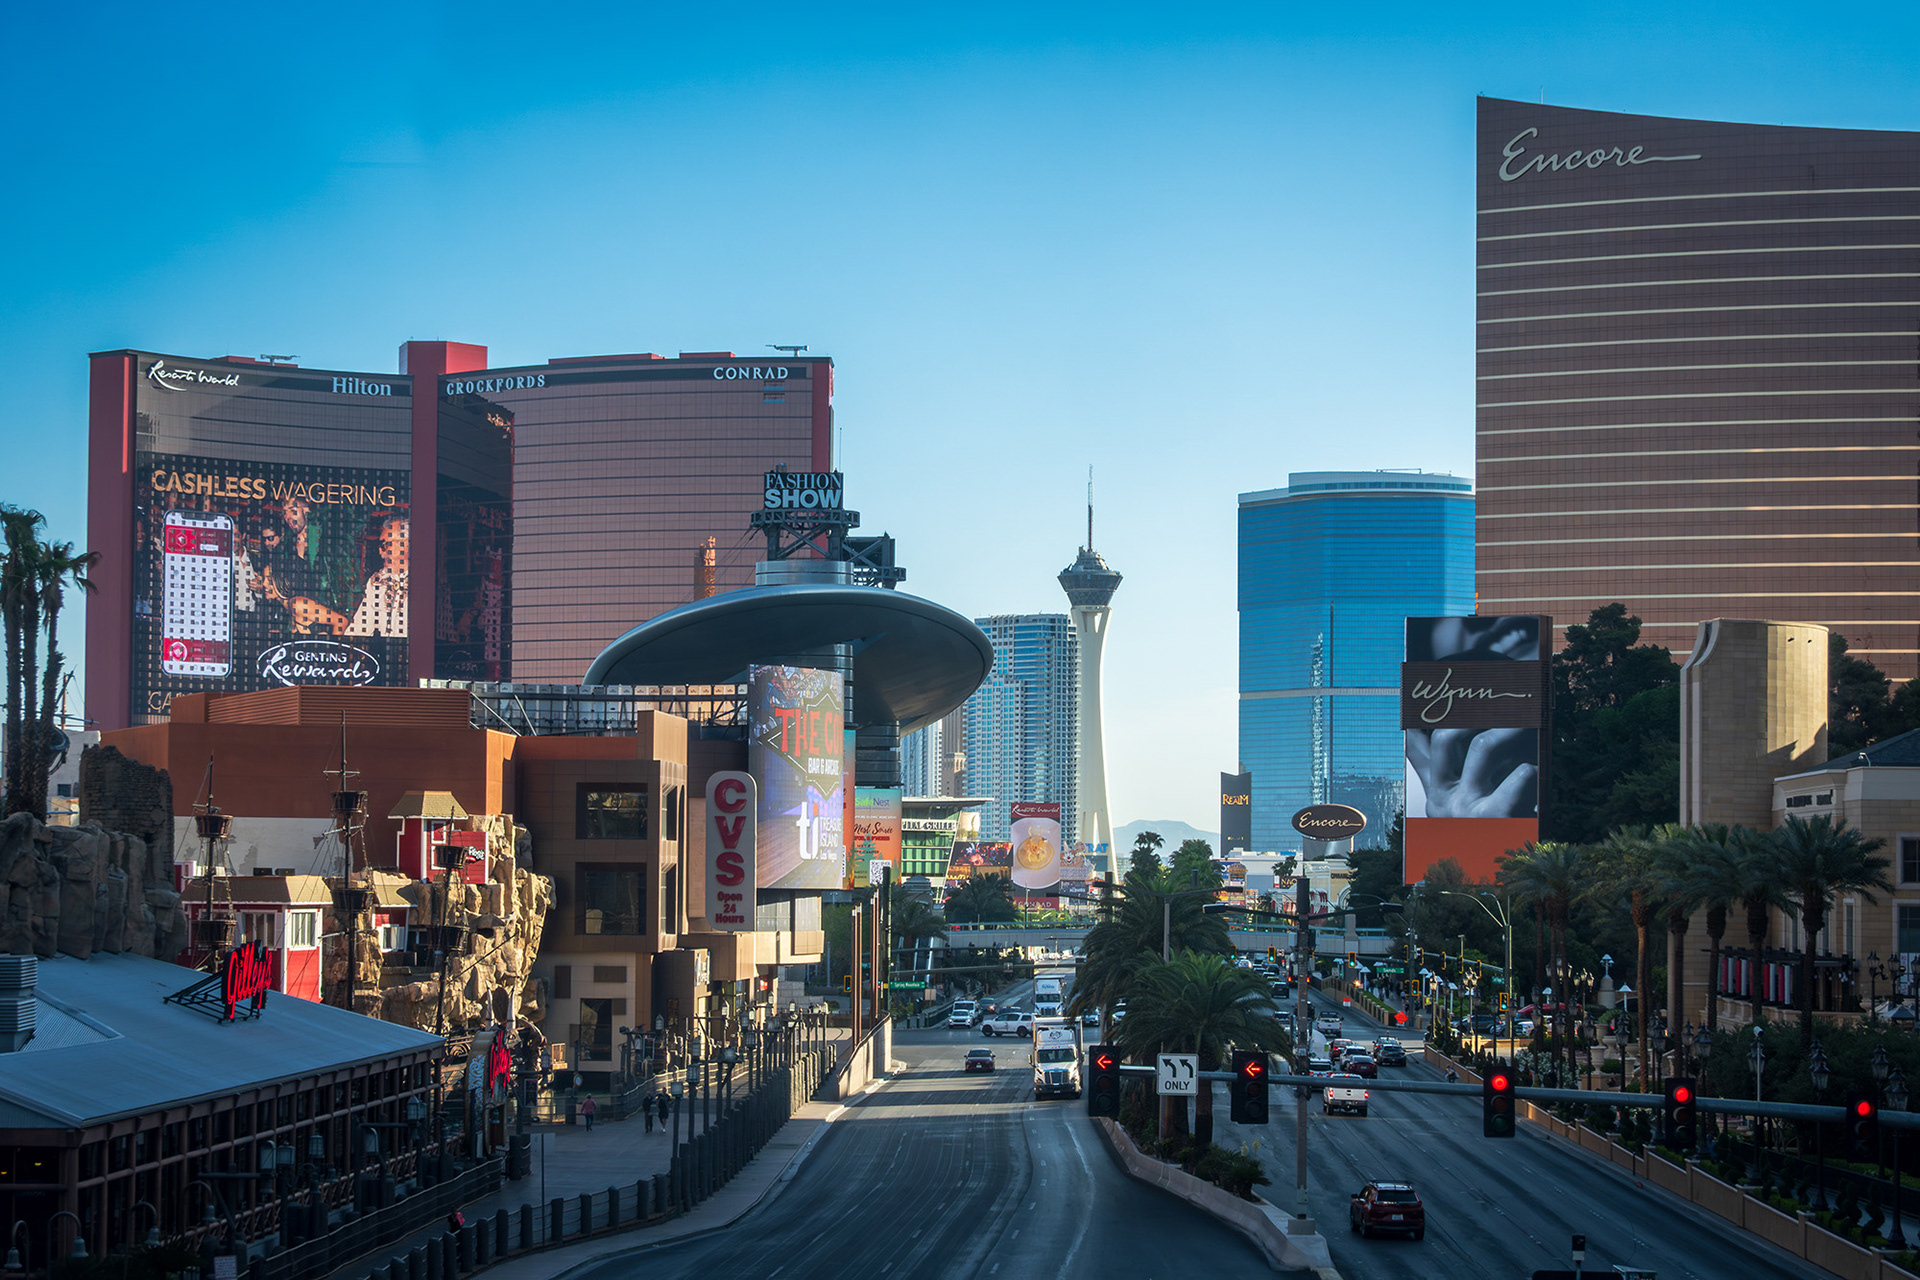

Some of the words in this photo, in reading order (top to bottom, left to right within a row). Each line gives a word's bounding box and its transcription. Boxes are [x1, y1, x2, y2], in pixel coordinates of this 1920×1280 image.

[1499, 127, 1702, 182] Encore
[148, 359, 196, 392] Resorts
[198, 370, 240, 387] World
[713, 366, 789, 380] CONRAD
[332, 376, 391, 396] Hilton
[446, 374, 546, 396] CROCKFORDS
[152, 469, 266, 500] CASHLESS
[272, 480, 396, 507] WAGERING
[765, 472, 842, 490] FASHION
[764, 489, 842, 508] SHOW
[294, 650, 348, 664] GENTING
[263, 647, 371, 688] Rewards
[774, 707, 821, 758] THE
[808, 757, 820, 775] BAR
[1299, 811, 1362, 829] Encore
[714, 778, 747, 887] CVS
[820, 833, 838, 848] ISLAND
[717, 891, 743, 904] Open
[723, 903, 736, 914] 24
[715, 913, 745, 924] Hours
[1164, 1080, 1190, 1091] ONLY
